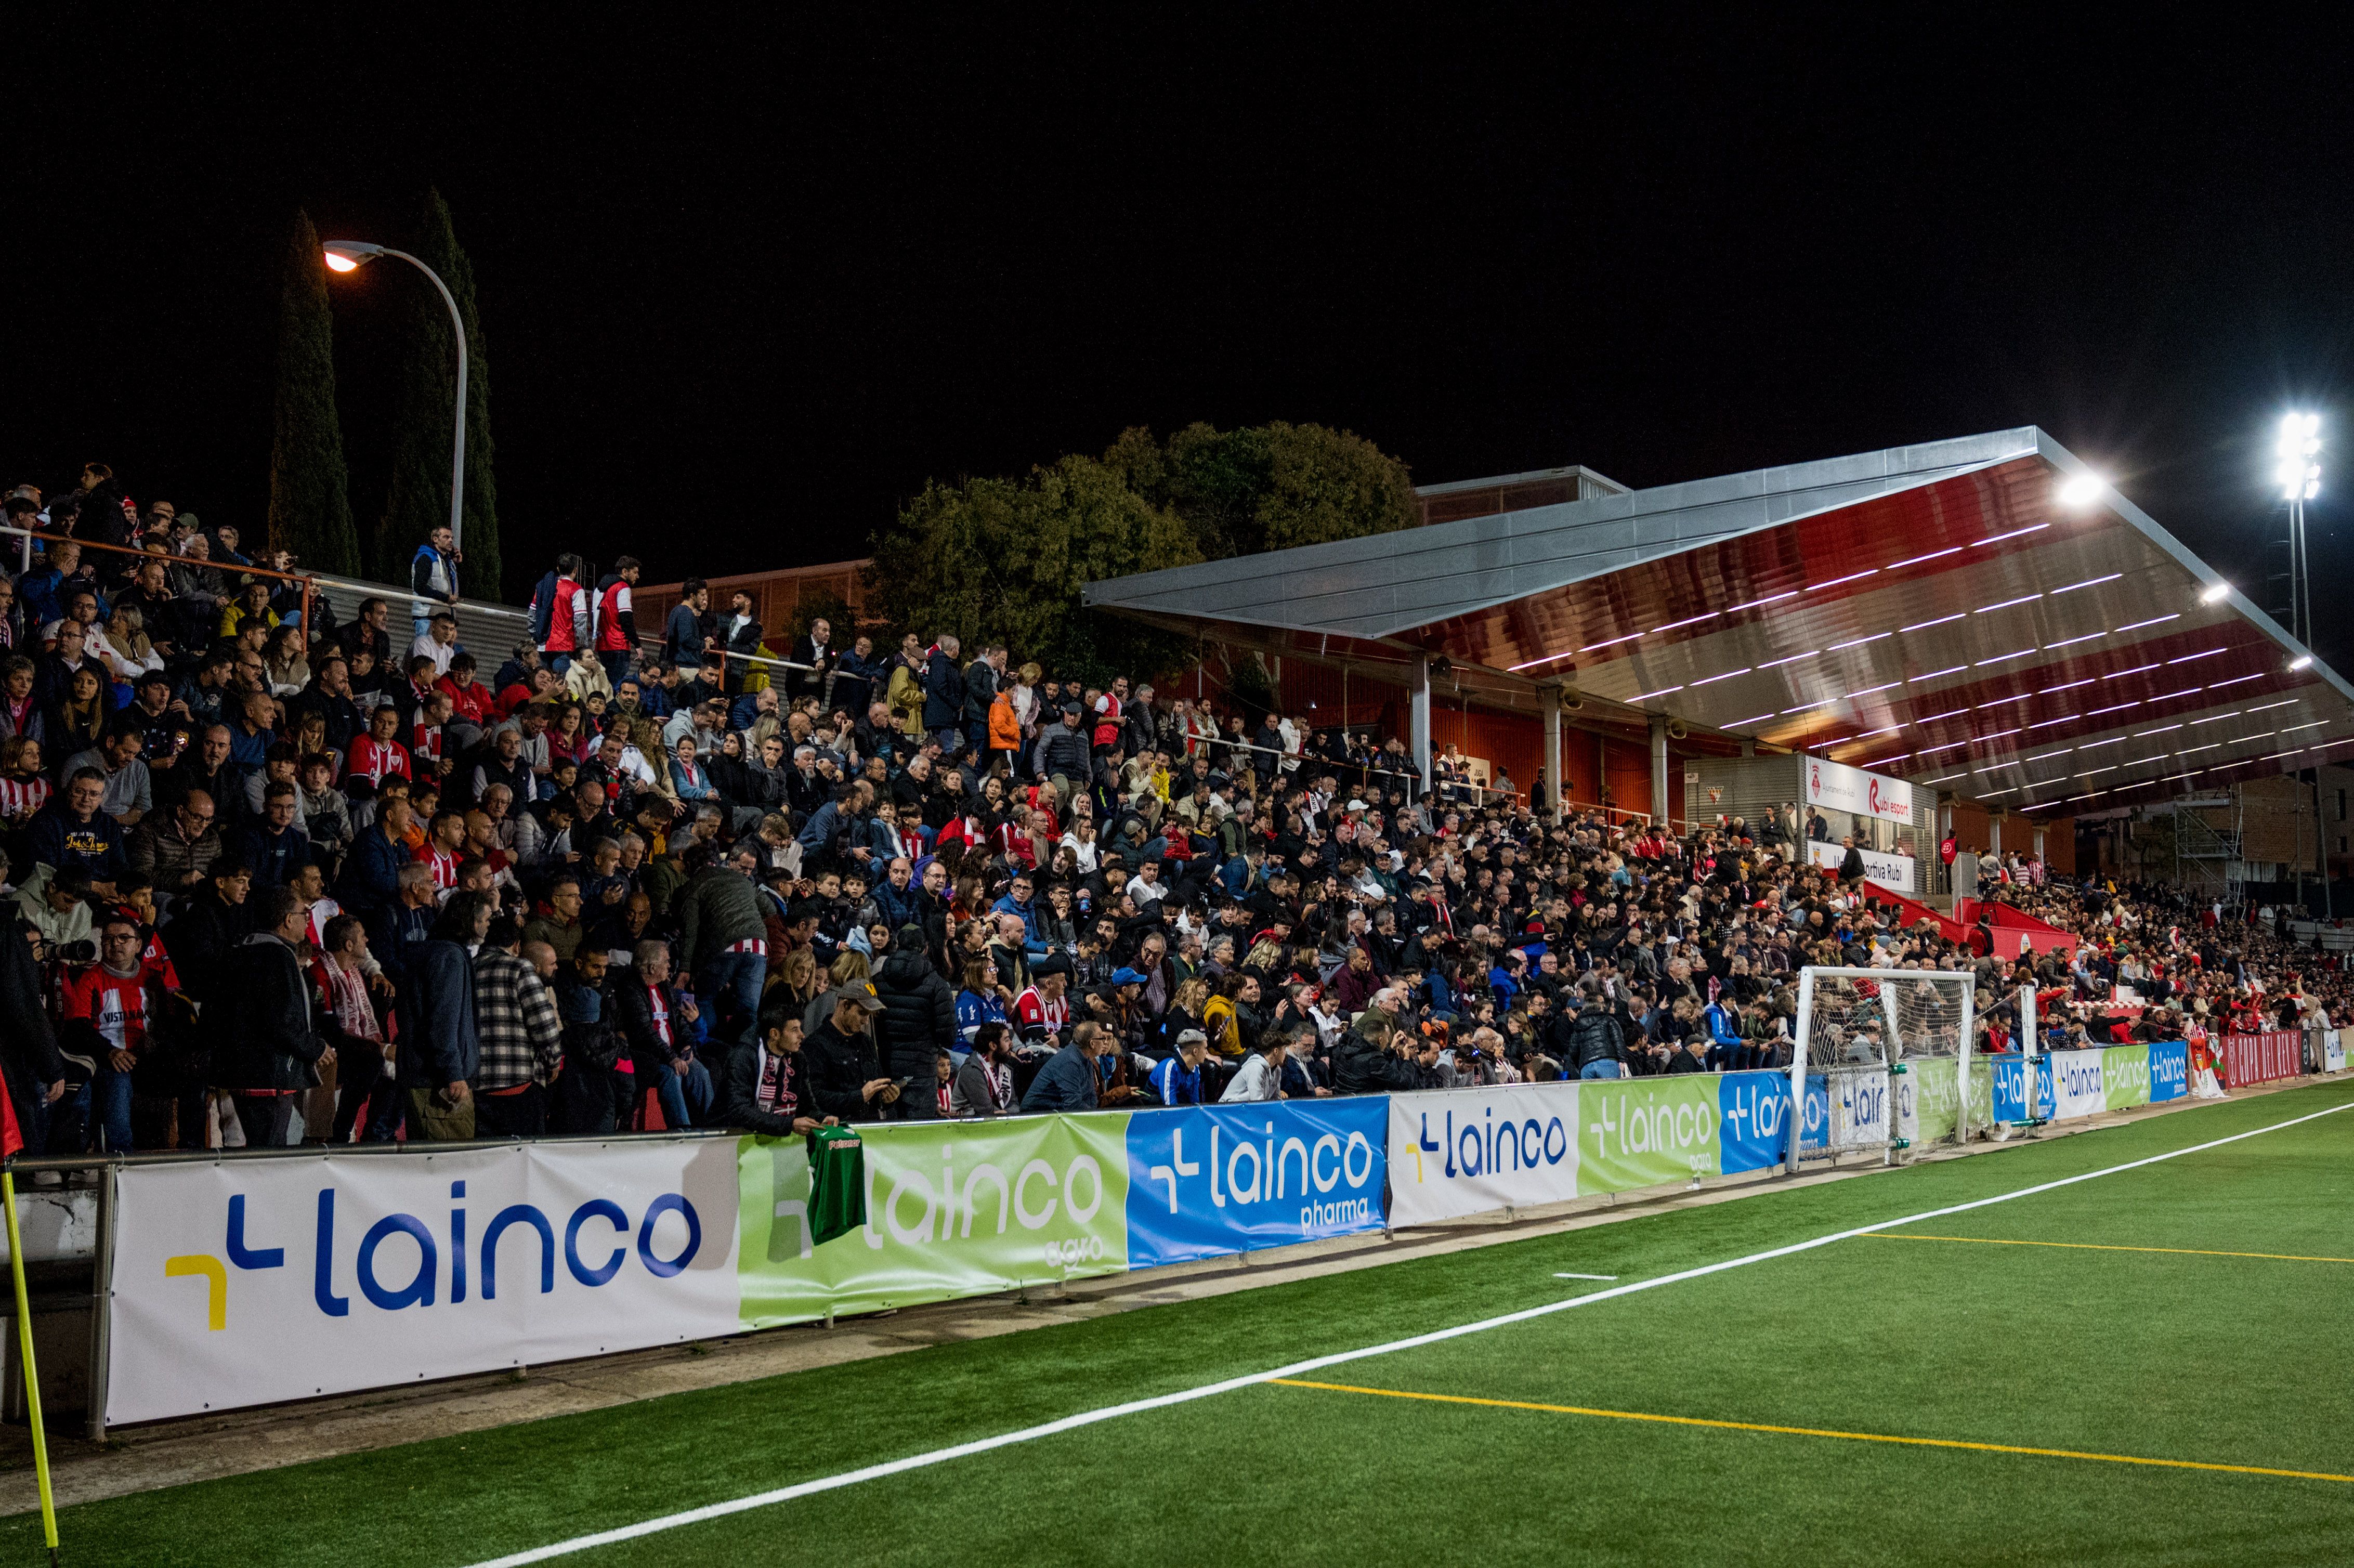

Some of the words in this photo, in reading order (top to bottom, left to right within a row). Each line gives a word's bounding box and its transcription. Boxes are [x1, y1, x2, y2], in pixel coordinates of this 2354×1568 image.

[1890, 802, 1908, 818] esport
[1865, 861, 1886, 879] ortiva
[1888, 864, 1902, 881] Rubí
[2159, 1051, 2186, 1083] lainco
[2239, 1037, 2259, 1083] COPA
[2261, 1036, 2275, 1079] DEL
[2277, 1034, 2291, 1076] REY
[2066, 1061, 2101, 1097] lainco
[1621, 1093, 1711, 1153] lainco
[829, 1139, 861, 1151] Petronor
[1445, 1107, 1566, 1178] lainco
[1210, 1121, 1372, 1207] lainco
[863, 1145, 1102, 1249] lainco
[1301, 1197, 1368, 1235] pharma
[314, 1180, 702, 1317] lainco
[1045, 1235, 1104, 1273] agro
